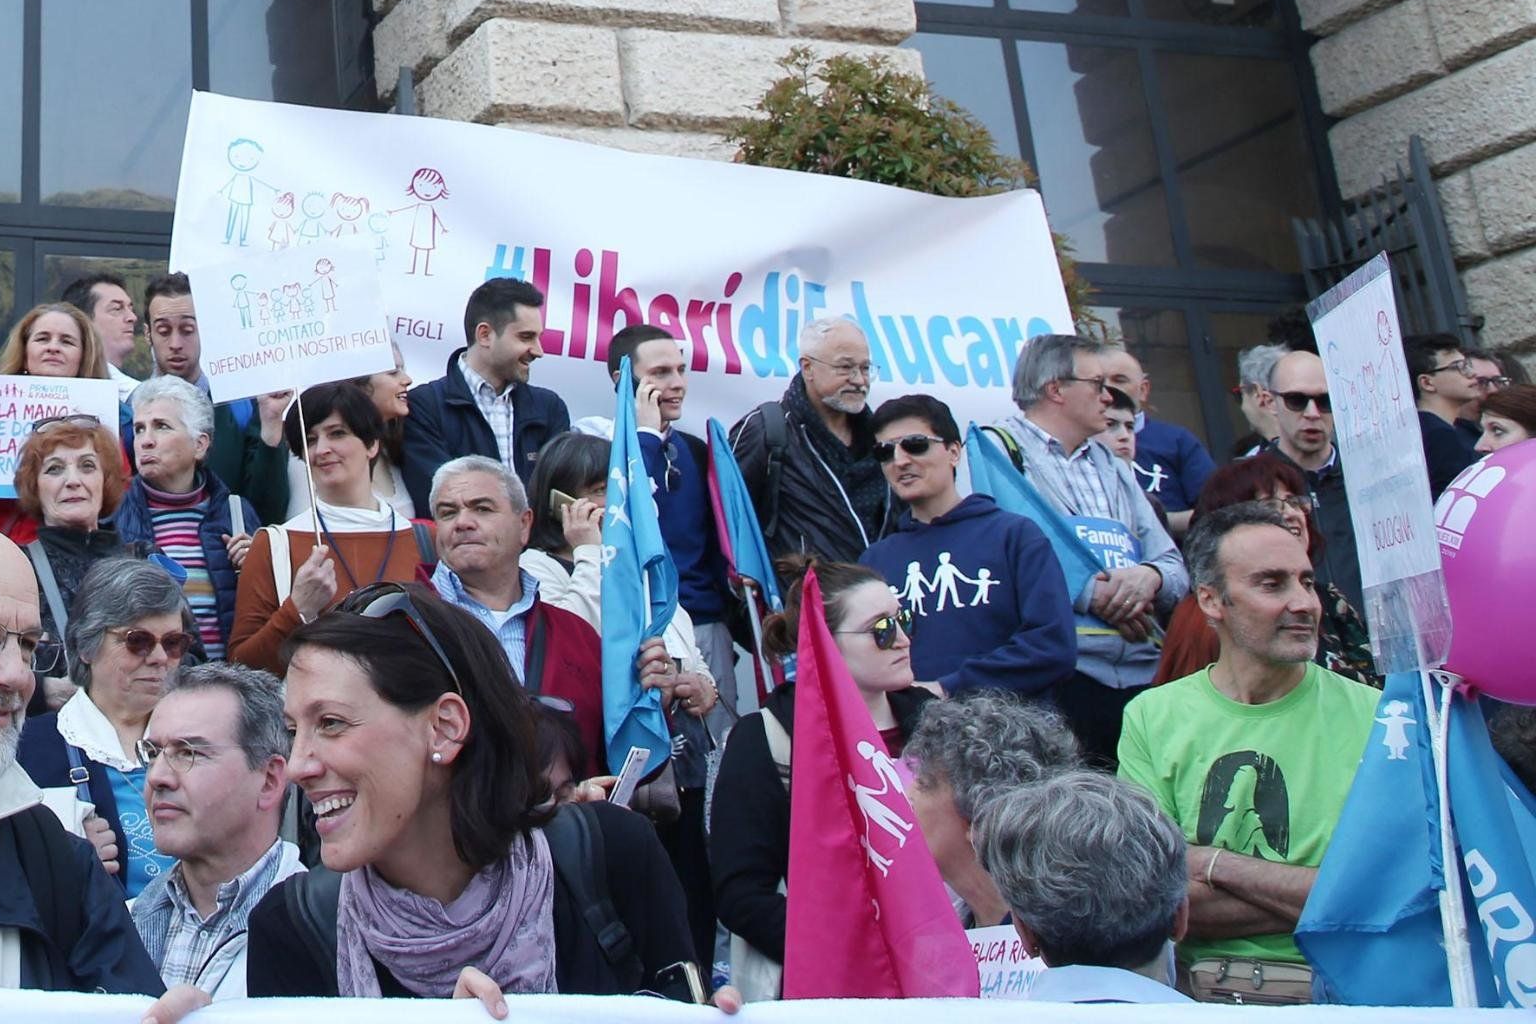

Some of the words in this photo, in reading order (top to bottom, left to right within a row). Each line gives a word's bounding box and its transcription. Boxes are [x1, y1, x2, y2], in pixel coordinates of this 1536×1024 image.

[258, 321, 325, 347] COMITATO
[395, 316, 444, 341] FIGLI
[209, 347, 285, 376] DIFENDIAMO
[298, 336, 348, 359] NOSTRI
[352, 328, 387, 349] FIGLI
[23, 404, 69, 420] MANO
